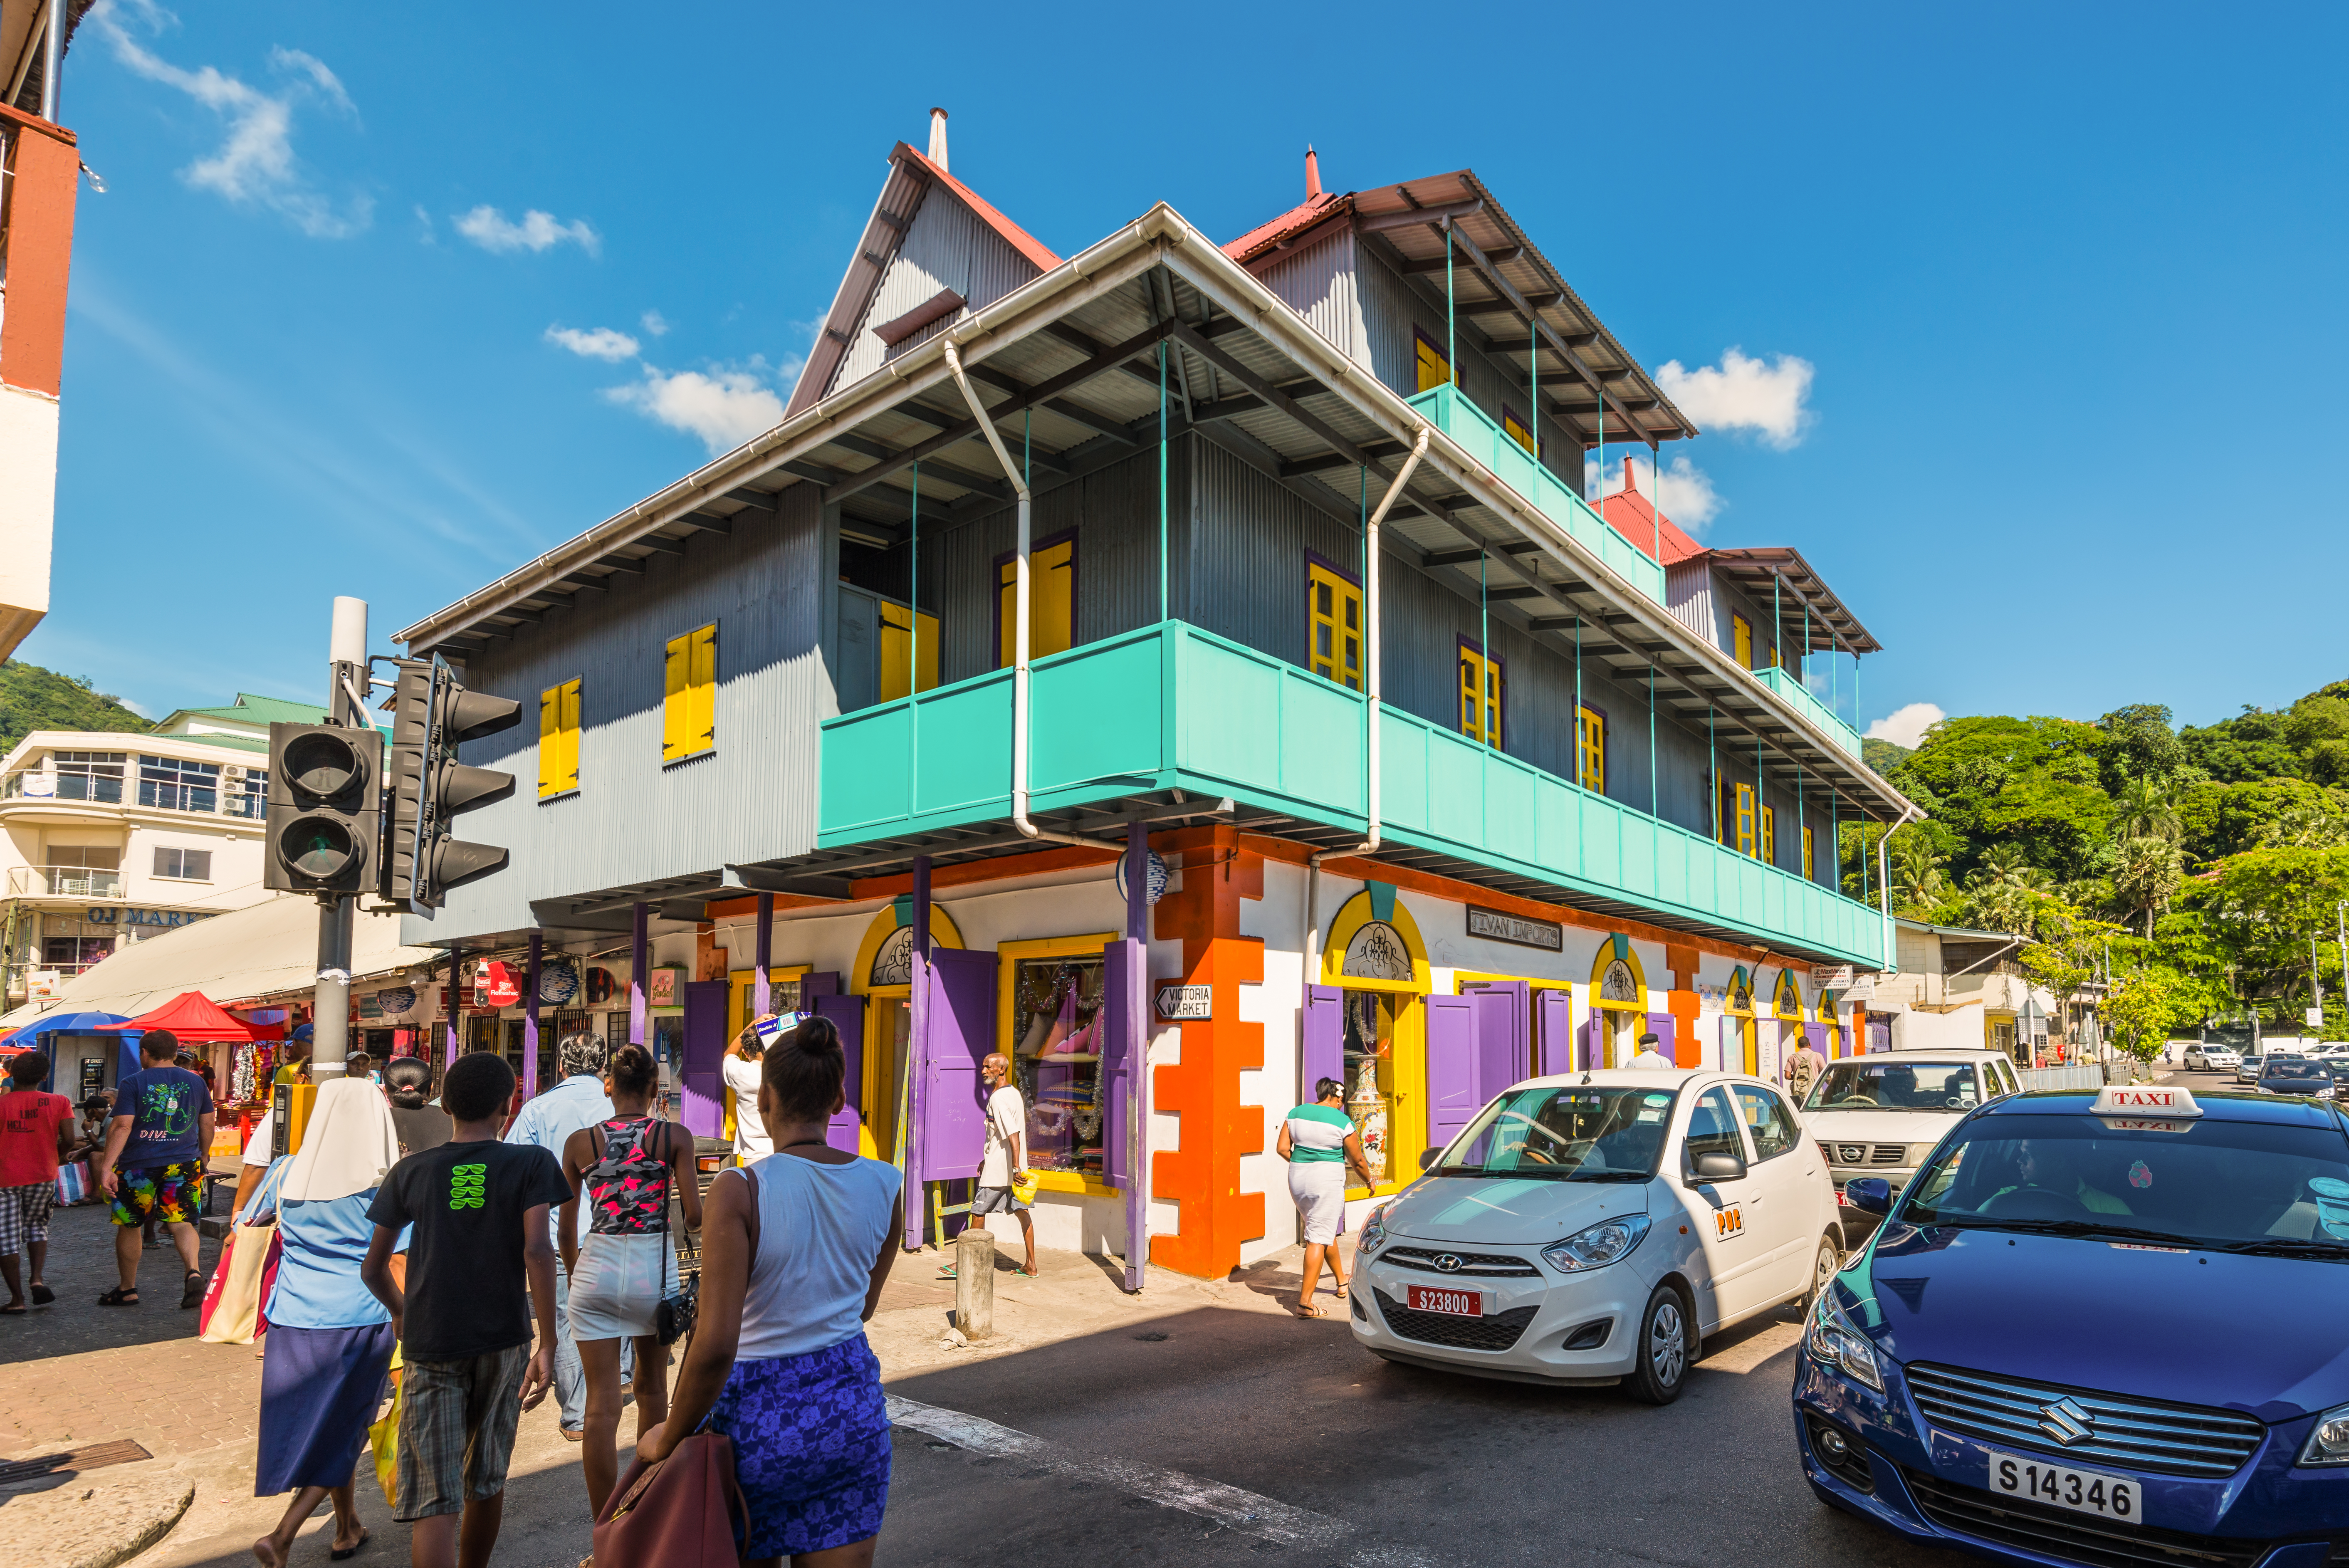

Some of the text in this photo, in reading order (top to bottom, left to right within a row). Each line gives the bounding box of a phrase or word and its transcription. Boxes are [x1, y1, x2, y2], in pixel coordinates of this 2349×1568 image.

[88, 908, 216, 926] OJ MARK
[1471, 911, 1558, 946] JIVAN IMPORTS
[652, 984, 674, 1001] Grolsch
[1169, 987, 1209, 1001] VICTORIA
[1168, 1002, 1208, 1016] MARKET
[38, 1097, 49, 1107] GO
[2114, 1093, 2171, 1106] TAXI
[20, 1108, 38, 1119] LIKE
[7, 1120, 28, 1130] HELL
[140, 1130, 168, 1139] DIVE
[1716, 1208, 1742, 1236] PUC
[676, 1250, 702, 1260] LITT
[1420, 1291, 1469, 1313] S23800
[1999, 1459, 2131, 1516] S14346
